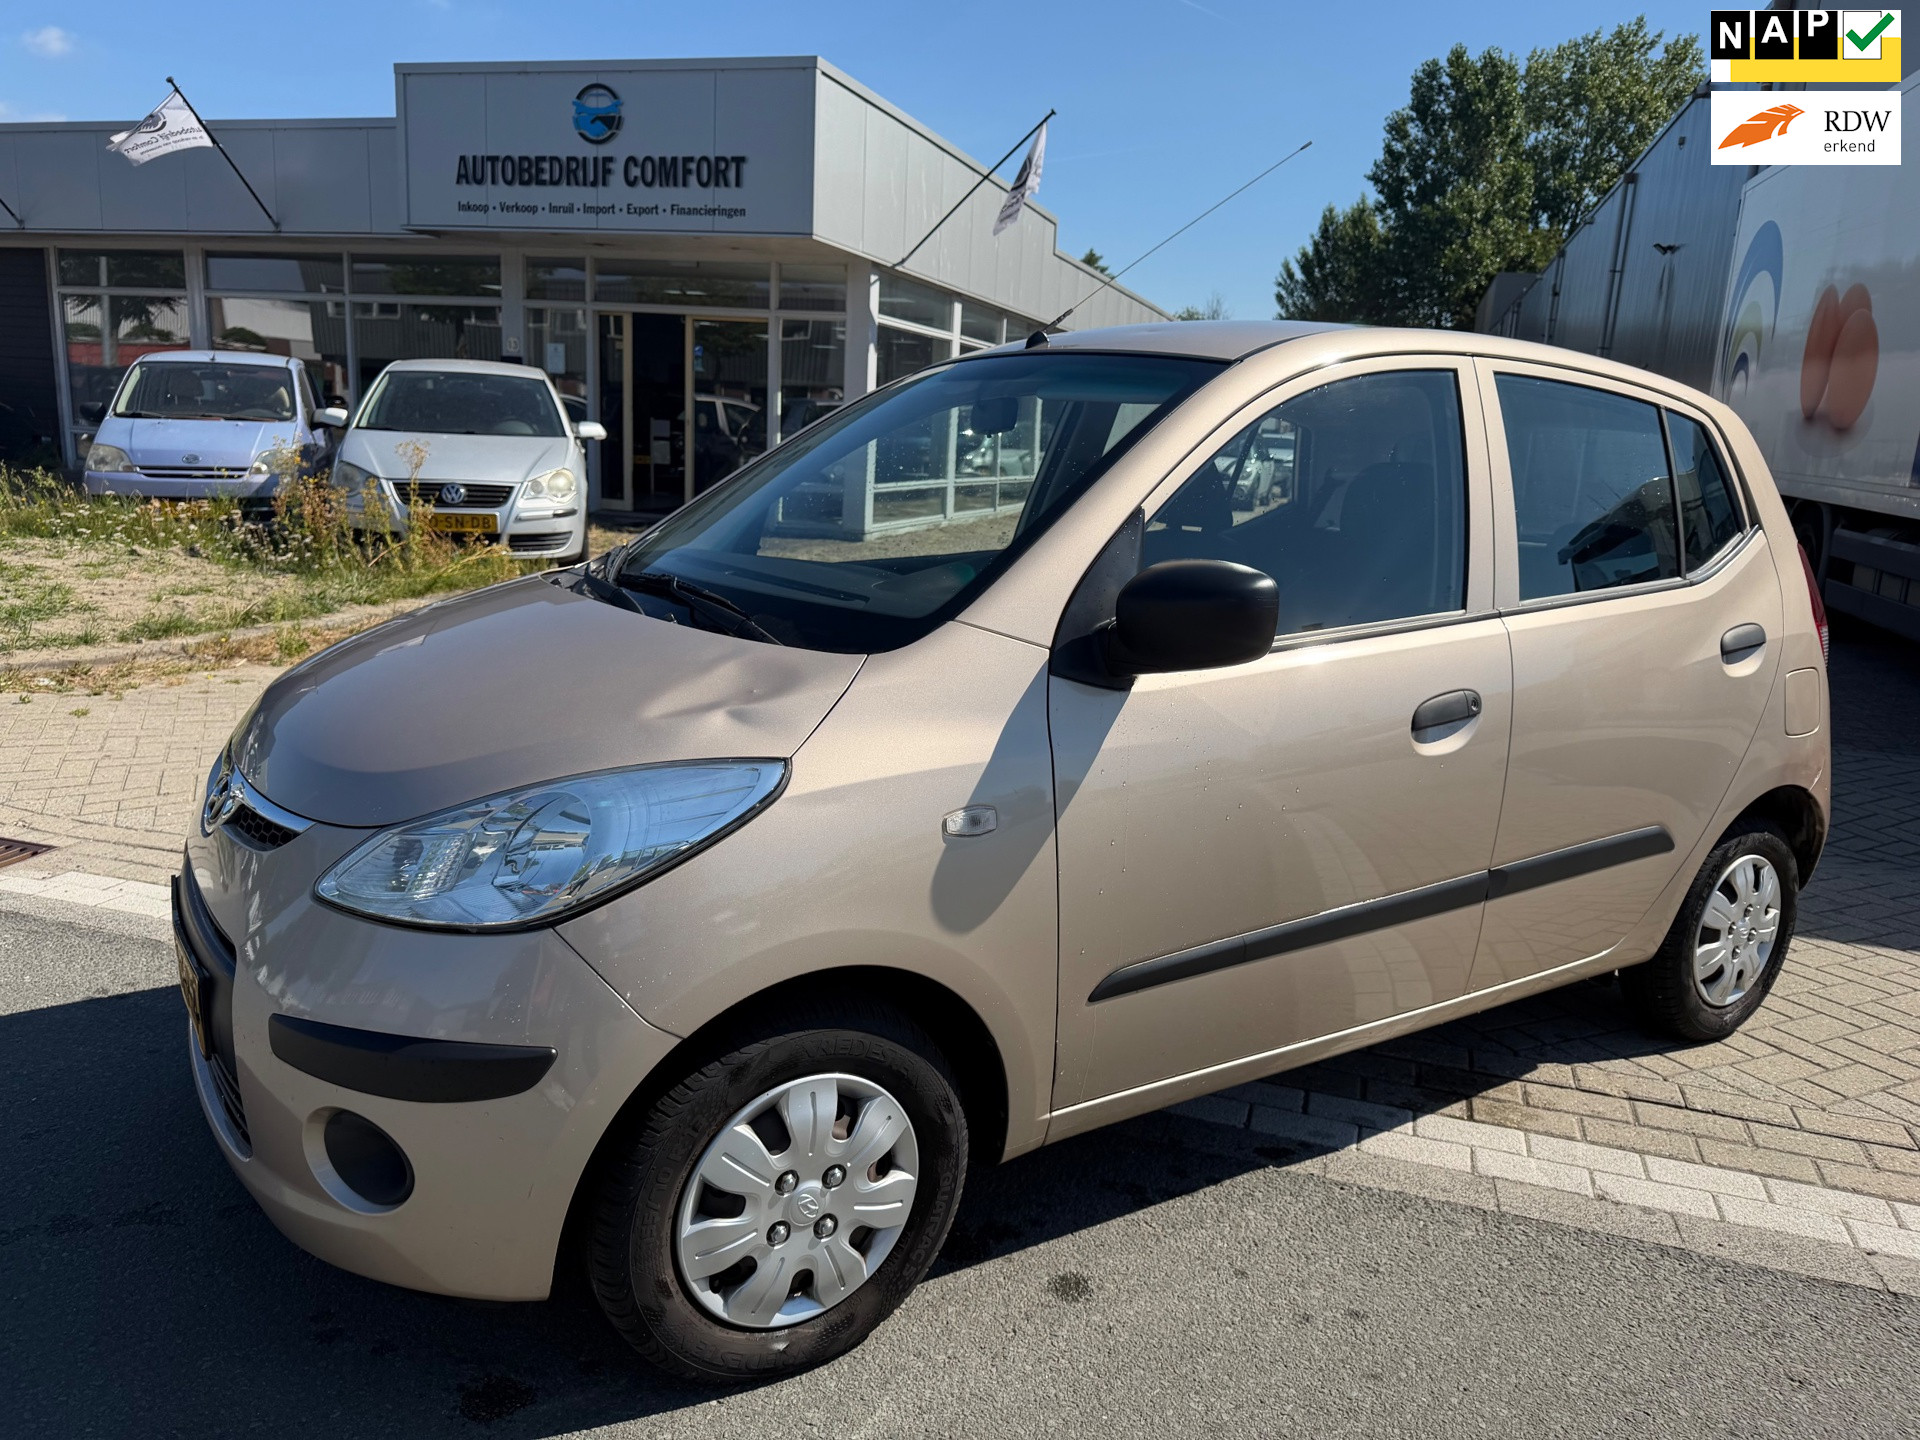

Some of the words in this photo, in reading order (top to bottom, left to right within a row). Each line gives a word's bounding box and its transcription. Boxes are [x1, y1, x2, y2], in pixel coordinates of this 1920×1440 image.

[455, 154, 616, 187] AUTOBEDRIJF
[623, 155, 748, 188] COMFORT
[458, 201, 489, 215] Inkoop
[500, 201, 538, 215] Verkoop
[549, 202, 575, 214] Inruil
[583, 203, 616, 217] Import
[626, 203, 659, 217] Export
[670, 204, 746, 219] Financieringen
